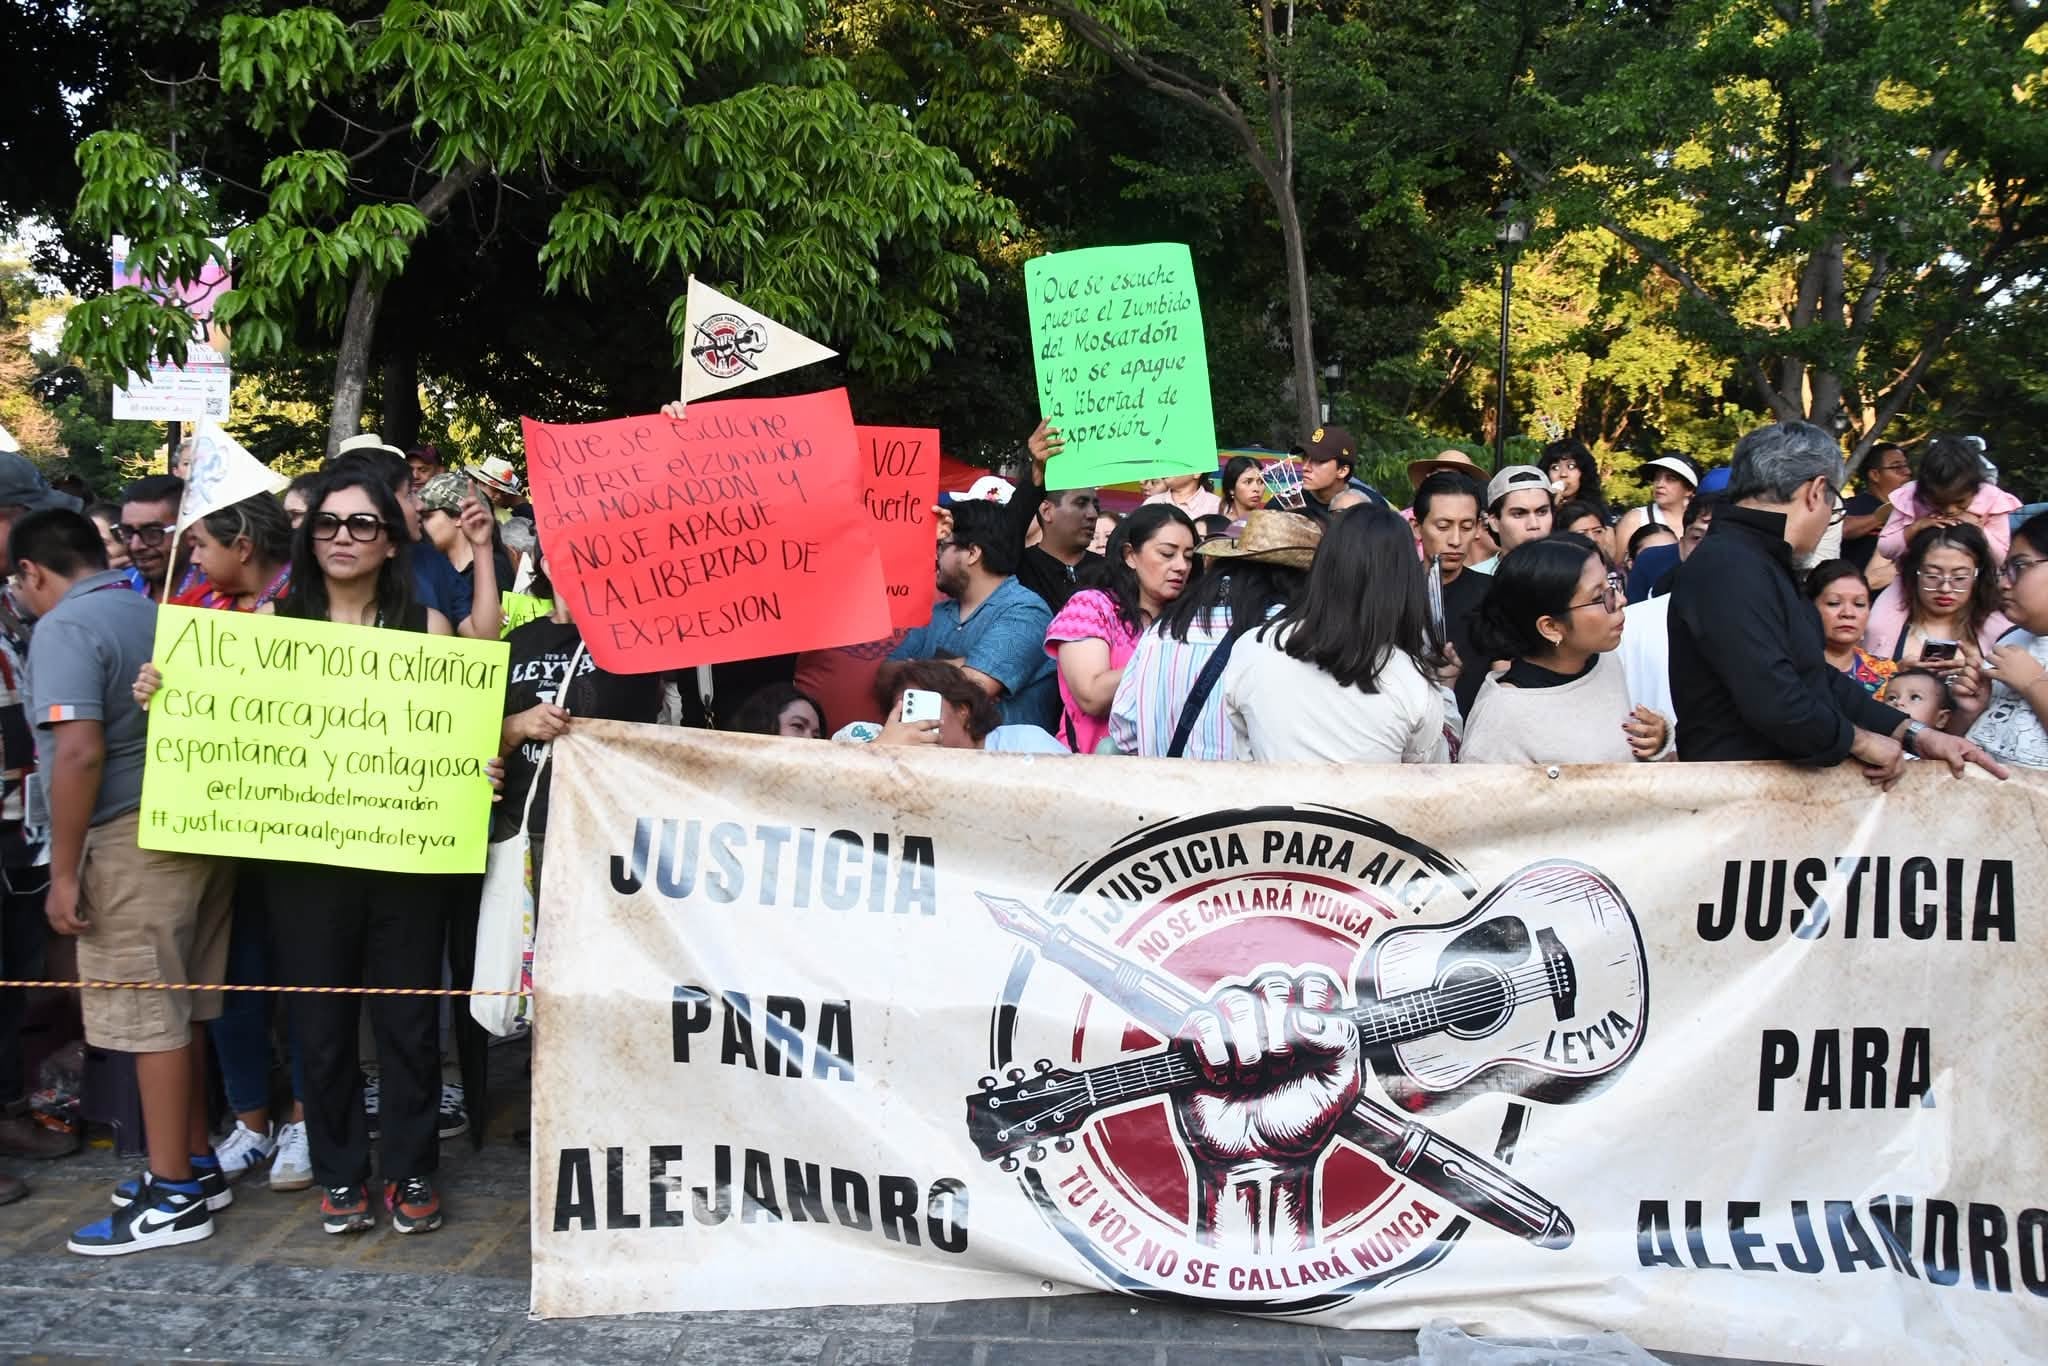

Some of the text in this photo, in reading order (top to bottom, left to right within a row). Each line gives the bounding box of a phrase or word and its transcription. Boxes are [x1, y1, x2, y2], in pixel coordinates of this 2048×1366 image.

[1084, 273, 1103, 296] se
[1110, 264, 1175, 291] escuche
[1041, 307, 1089, 336] fuerte
[1097, 300, 1113, 321] el
[1041, 319, 1178, 360] del Moscardón
[1044, 354, 1187, 396] y no se apague
[1048, 385, 1178, 417] la libertad de
[666, 451, 697, 478] el
[872, 437, 927, 477] VOZ
[864, 488, 923, 525] fuerte
[568, 500, 777, 575] NO SE APAGUE
[580, 578, 628, 617] LA
[630, 538, 768, 605] LIBERTAD
[781, 538, 822, 573] DE
[610, 591, 782, 650] EXPRESION
[164, 617, 246, 676] Ale,
[388, 645, 503, 690] extrañar
[163, 687, 452, 739] esa carcajada tan
[323, 750, 338, 782] y
[345, 746, 481, 793] contagiosa
[609, 816, 937, 917] JUSTICIA
[1261, 830, 1355, 873] PARA
[1136, 882, 1374, 962] NO SE CALLARÁ NUNCA
[1697, 855, 2016, 942] JUSTICIA
[671, 984, 856, 1082] PARA
[1543, 1010, 1635, 1064] LEYVA
[1757, 1027, 1936, 1112] PARA
[552, 1144, 970, 1254] ALEJANDRO
[1058, 1164, 1441, 1291] TU VOZ NO SE CALLARÁ NUNCA
[1636, 1194, 2048, 1299] ALEJANDRO
